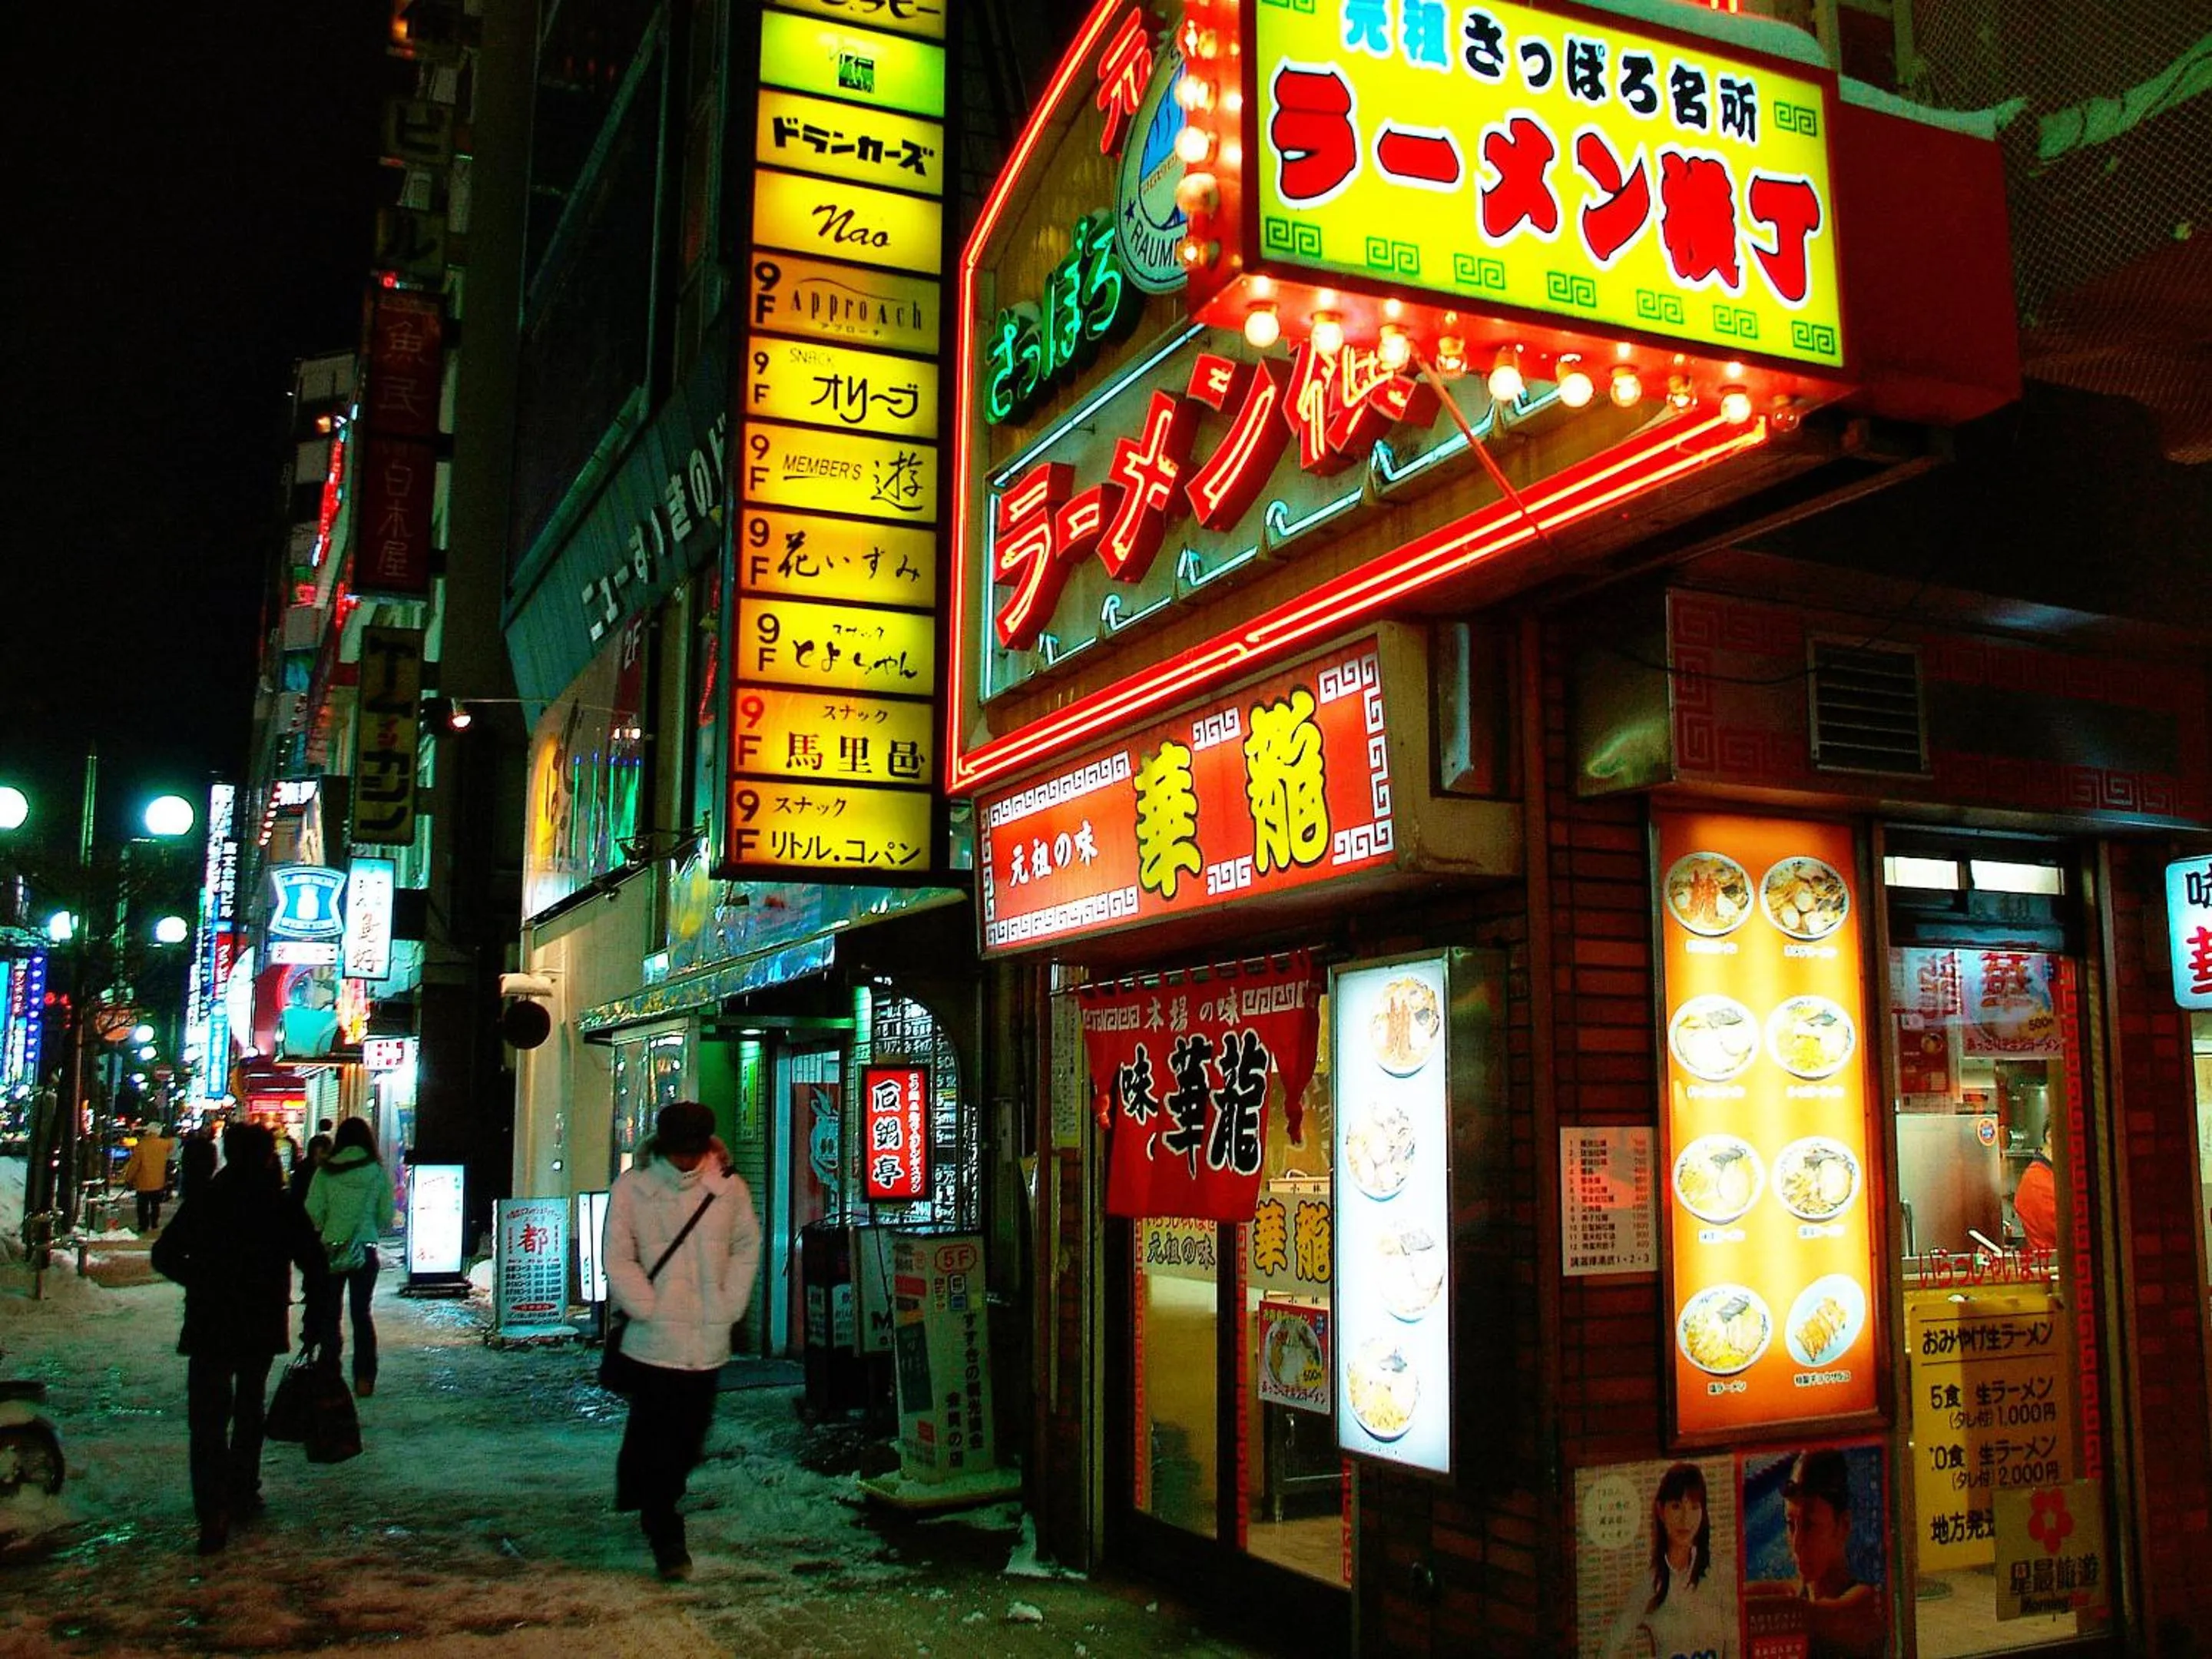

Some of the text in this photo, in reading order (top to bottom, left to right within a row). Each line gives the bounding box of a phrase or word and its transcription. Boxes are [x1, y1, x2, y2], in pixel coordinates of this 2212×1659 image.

[773, 117, 935, 177] ドランカーズ
[1272, 65, 1820, 302] ラーメン横丁
[812, 204, 891, 249] Nao
[985, 211, 1124, 426] さっぽろ
[783, 455, 863, 481] MEMBER'S
[824, 704, 889, 723] スナック
[786, 732, 925, 780] 馬里邑
[773, 795, 846, 818] スナック
[1008, 820, 1098, 888] 元祖の味
[1144, 986, 1241, 1033] 本場の味
[1147, 1230, 1217, 1270] 元祖の味
[1922, 1321, 2054, 1356] おみやげ生ラーメン
[1930, 1376, 2055, 1410] 5食 生ラーメン
[1979, 1436, 2057, 1468] 生ラーメン
